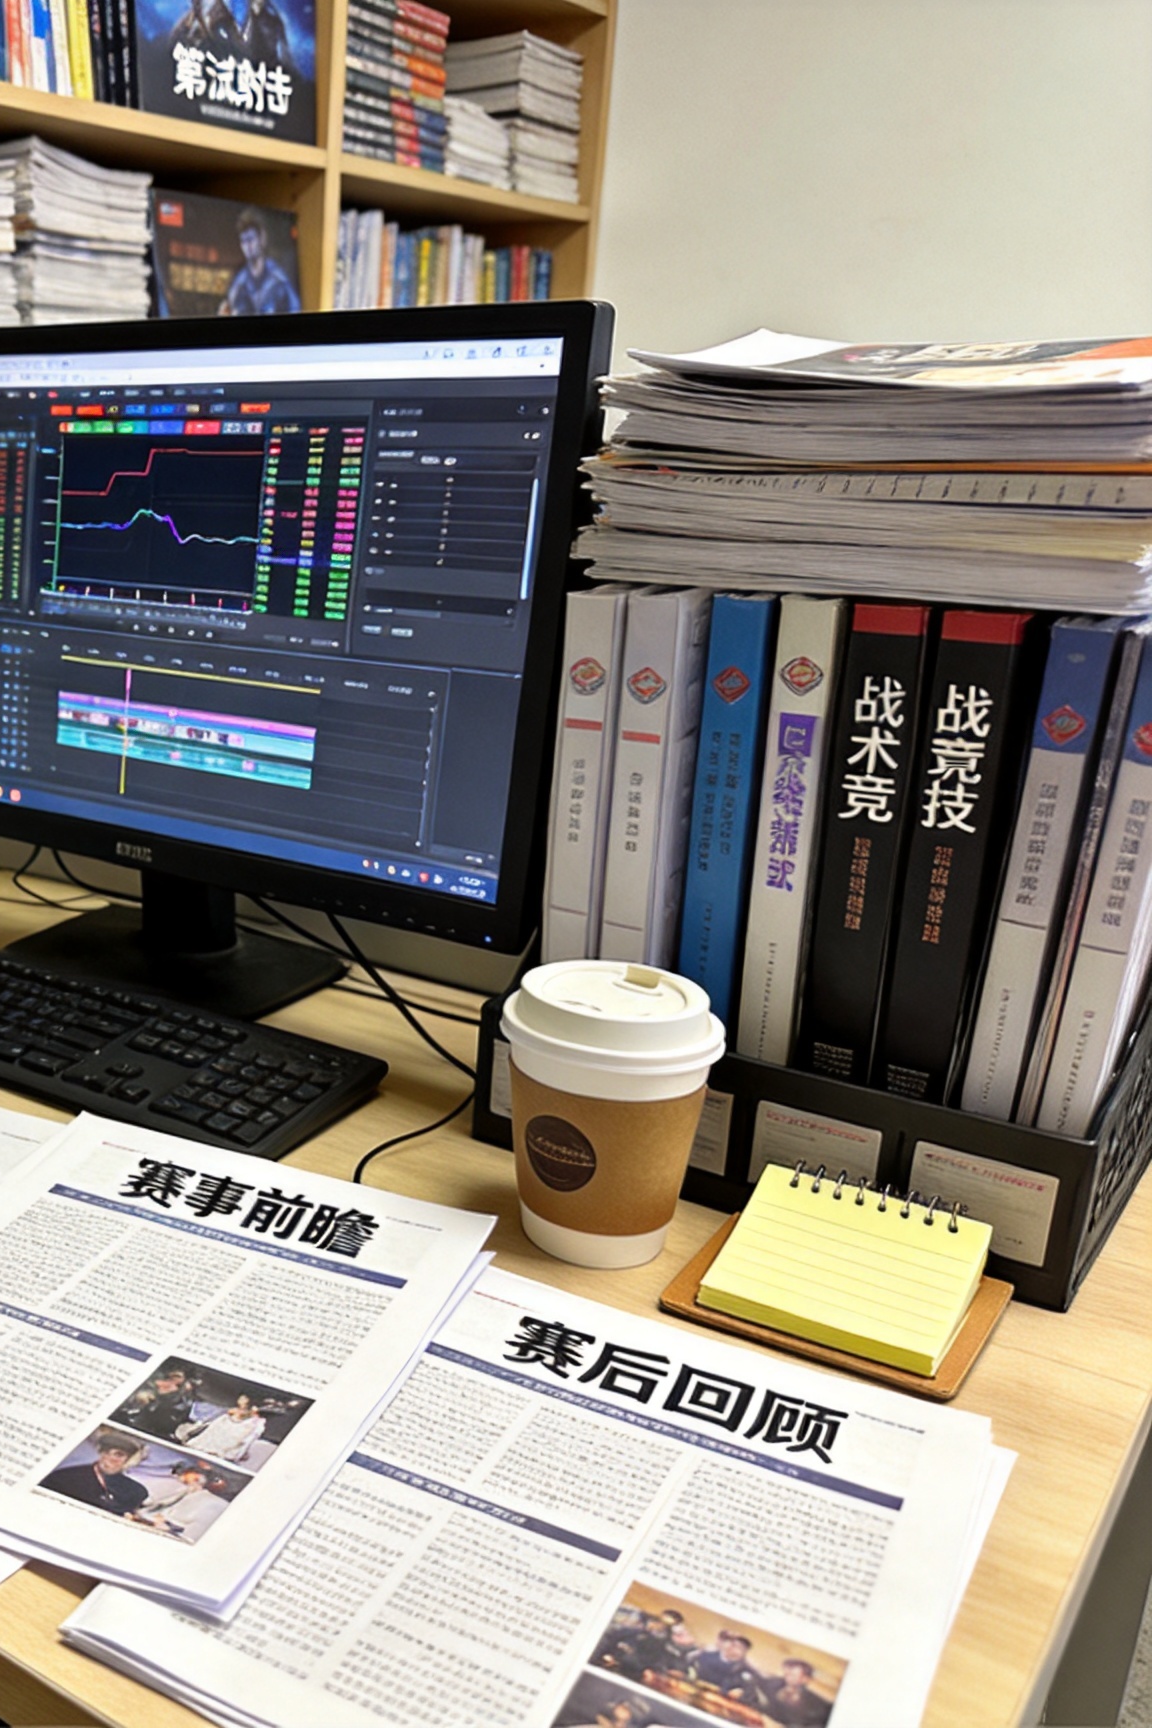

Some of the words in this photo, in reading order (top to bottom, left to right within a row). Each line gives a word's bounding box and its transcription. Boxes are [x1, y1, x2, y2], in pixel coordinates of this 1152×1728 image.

[837, 676, 906, 822] 战术竞
[118, 1158, 379, 1258] 赛事前瞻
[503, 1316, 849, 1464] 赛后回顾
